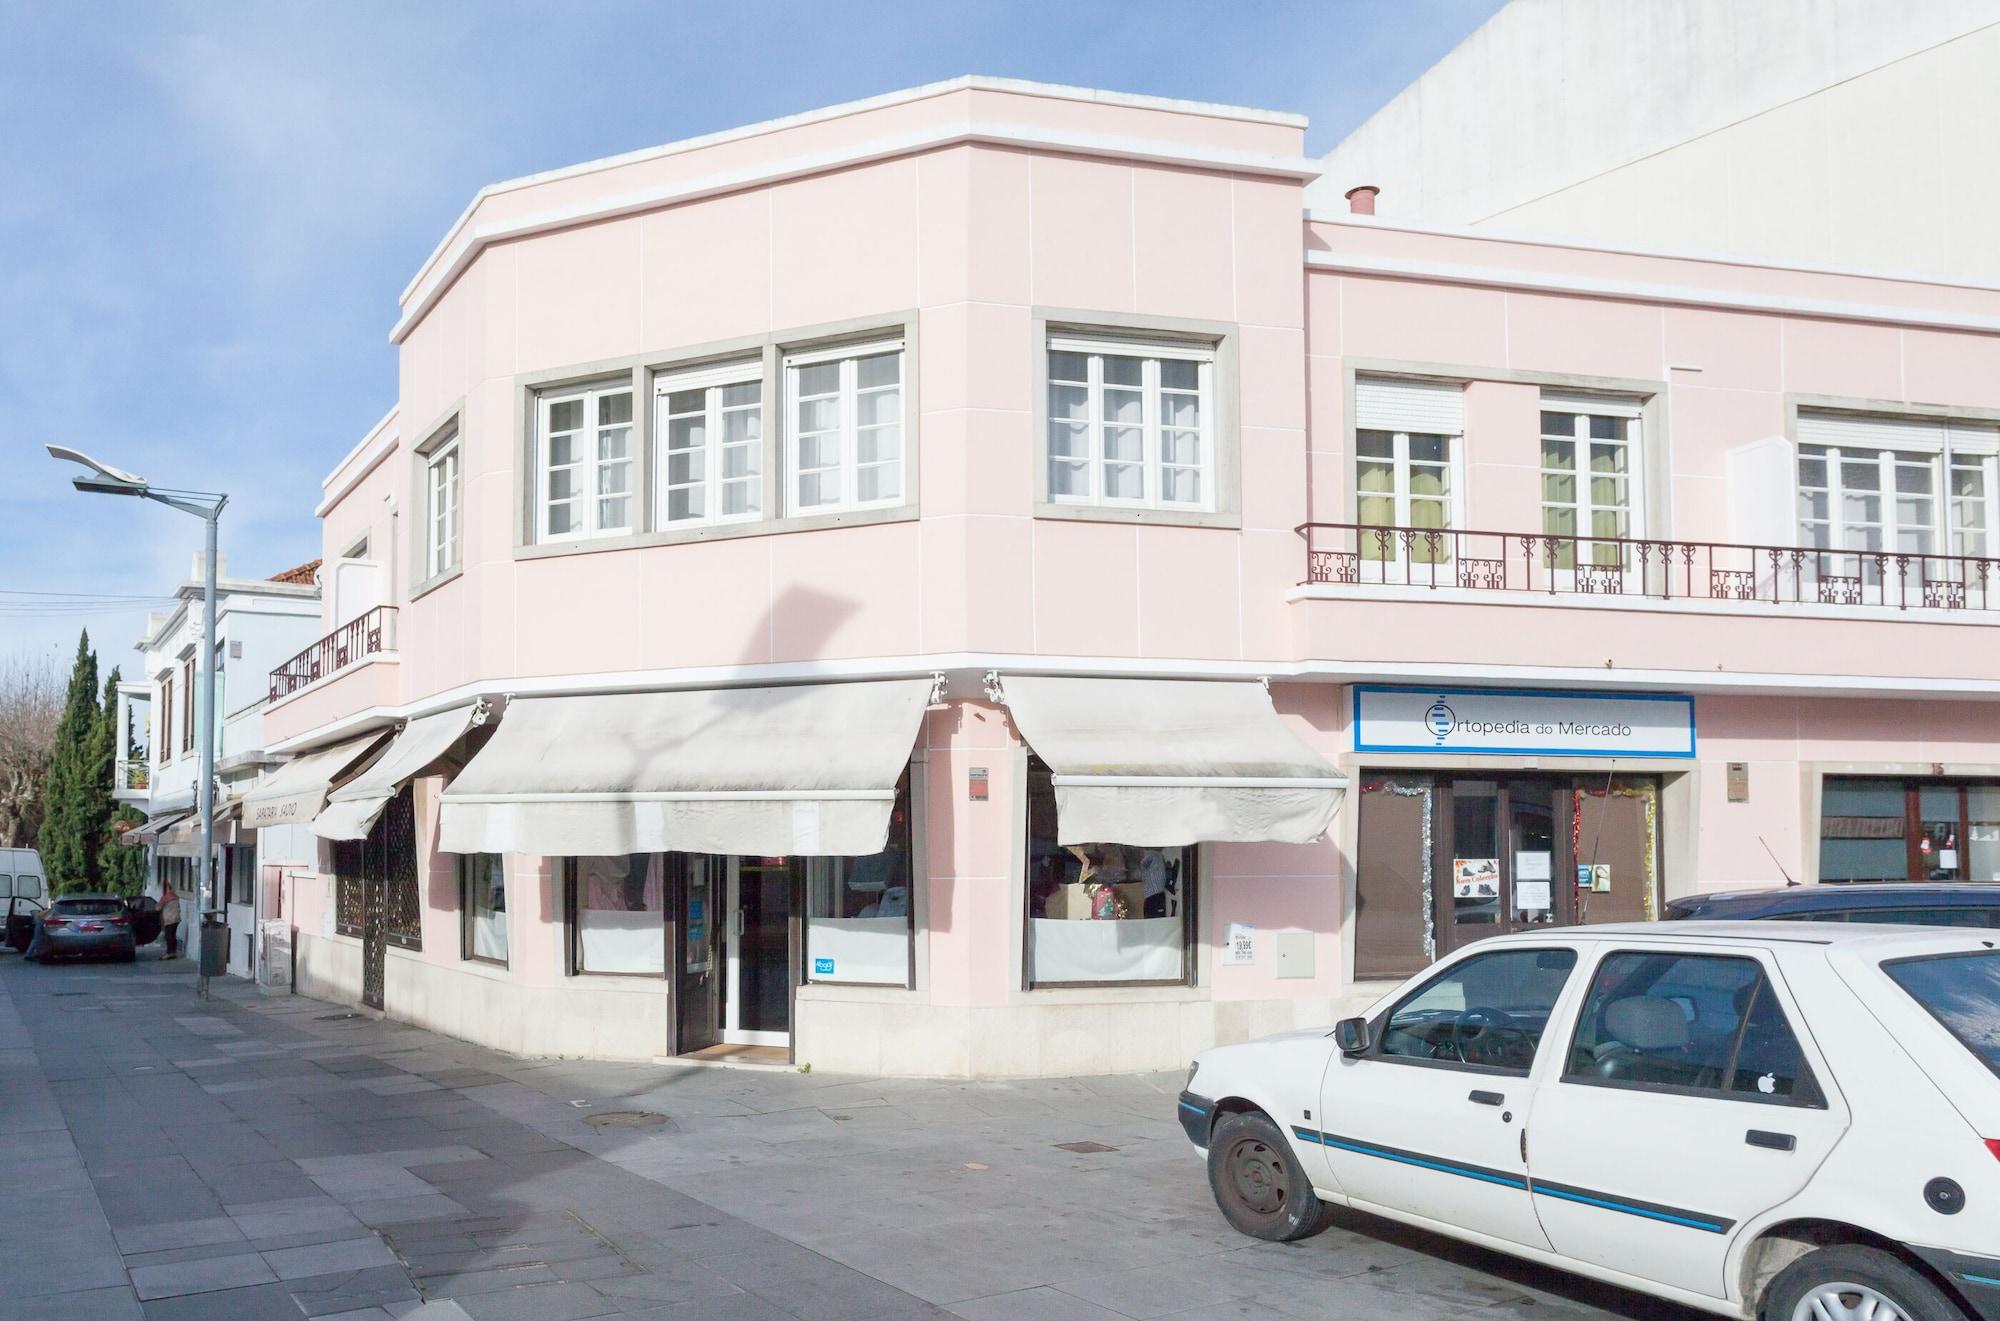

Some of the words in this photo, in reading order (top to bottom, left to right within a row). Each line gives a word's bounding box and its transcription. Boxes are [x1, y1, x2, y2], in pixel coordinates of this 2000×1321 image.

[1425, 704, 1530, 736] Ortopedia
[1535, 722, 1553, 735] do
[1559, 721, 1632, 737] Mercado
